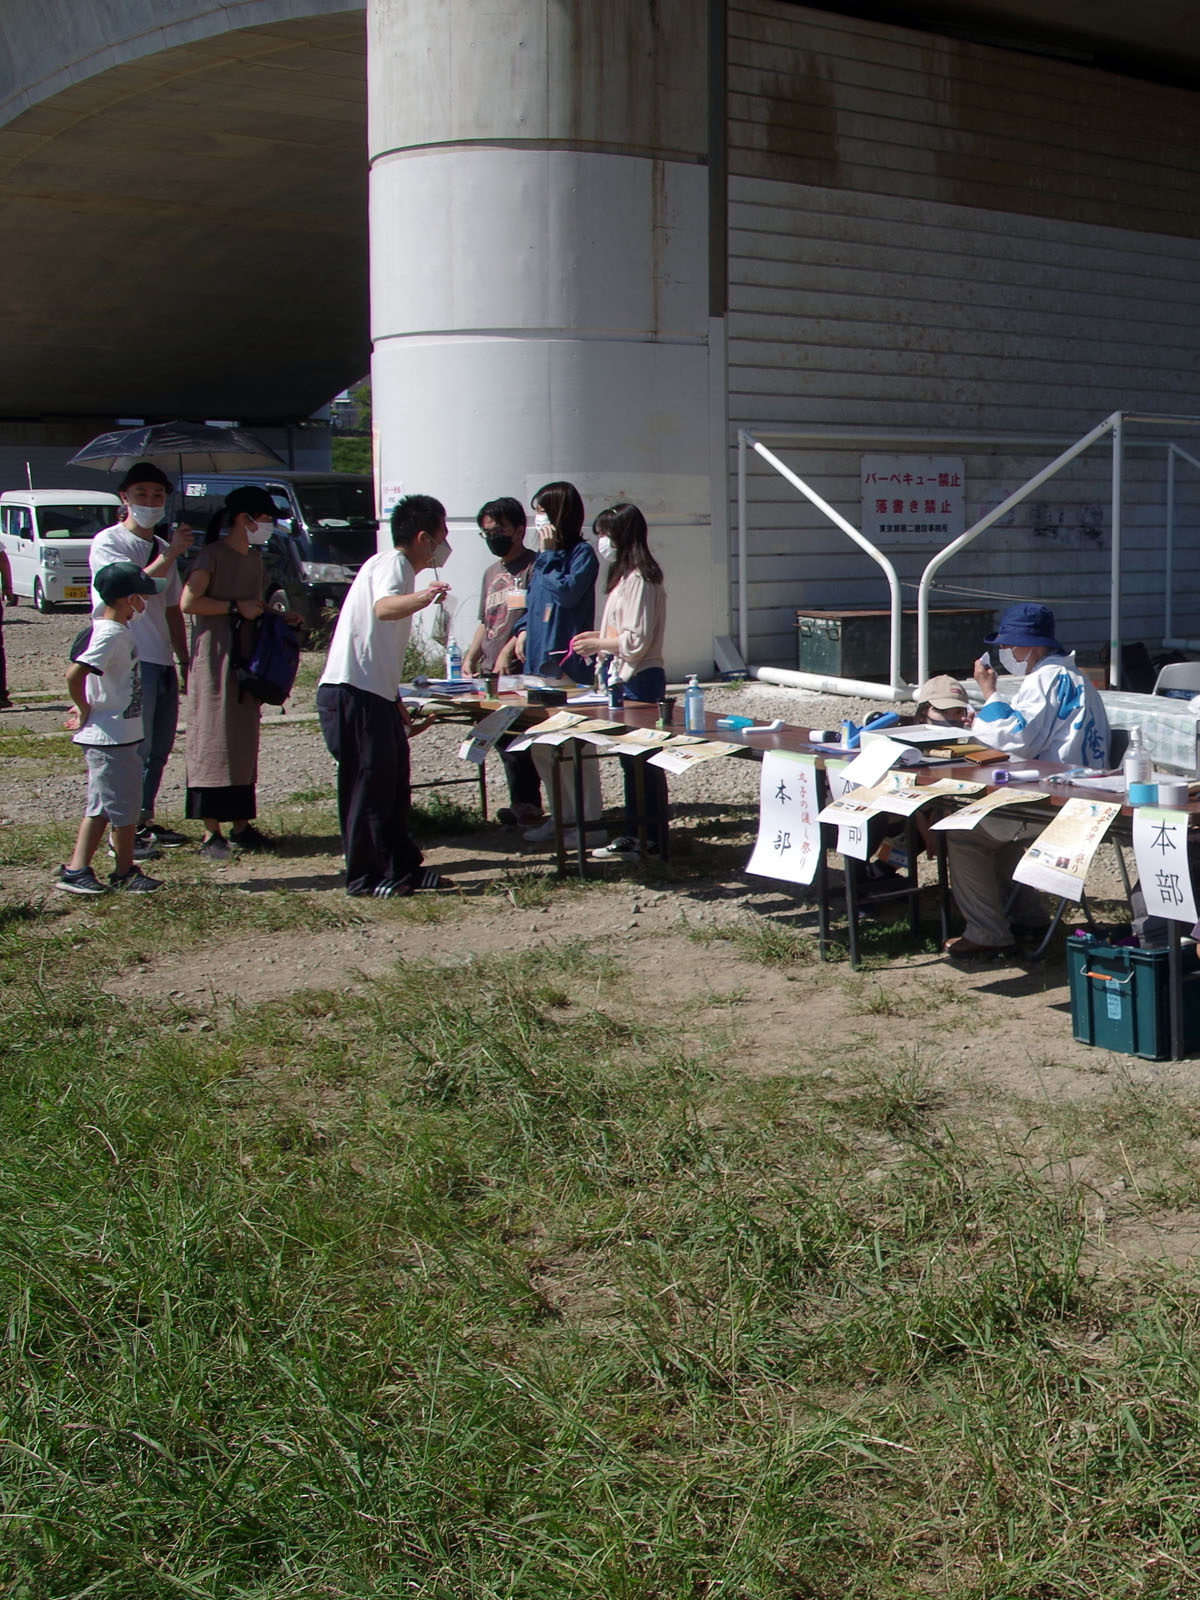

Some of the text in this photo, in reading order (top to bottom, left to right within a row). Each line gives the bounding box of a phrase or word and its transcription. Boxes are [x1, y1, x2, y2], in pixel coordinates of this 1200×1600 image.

[865, 472, 961, 488] バーベキュー禁止
[875, 498, 953, 514] 落書き禁止
[773, 779, 792, 857] 本部
[1151, 818, 1184, 906] 本部
